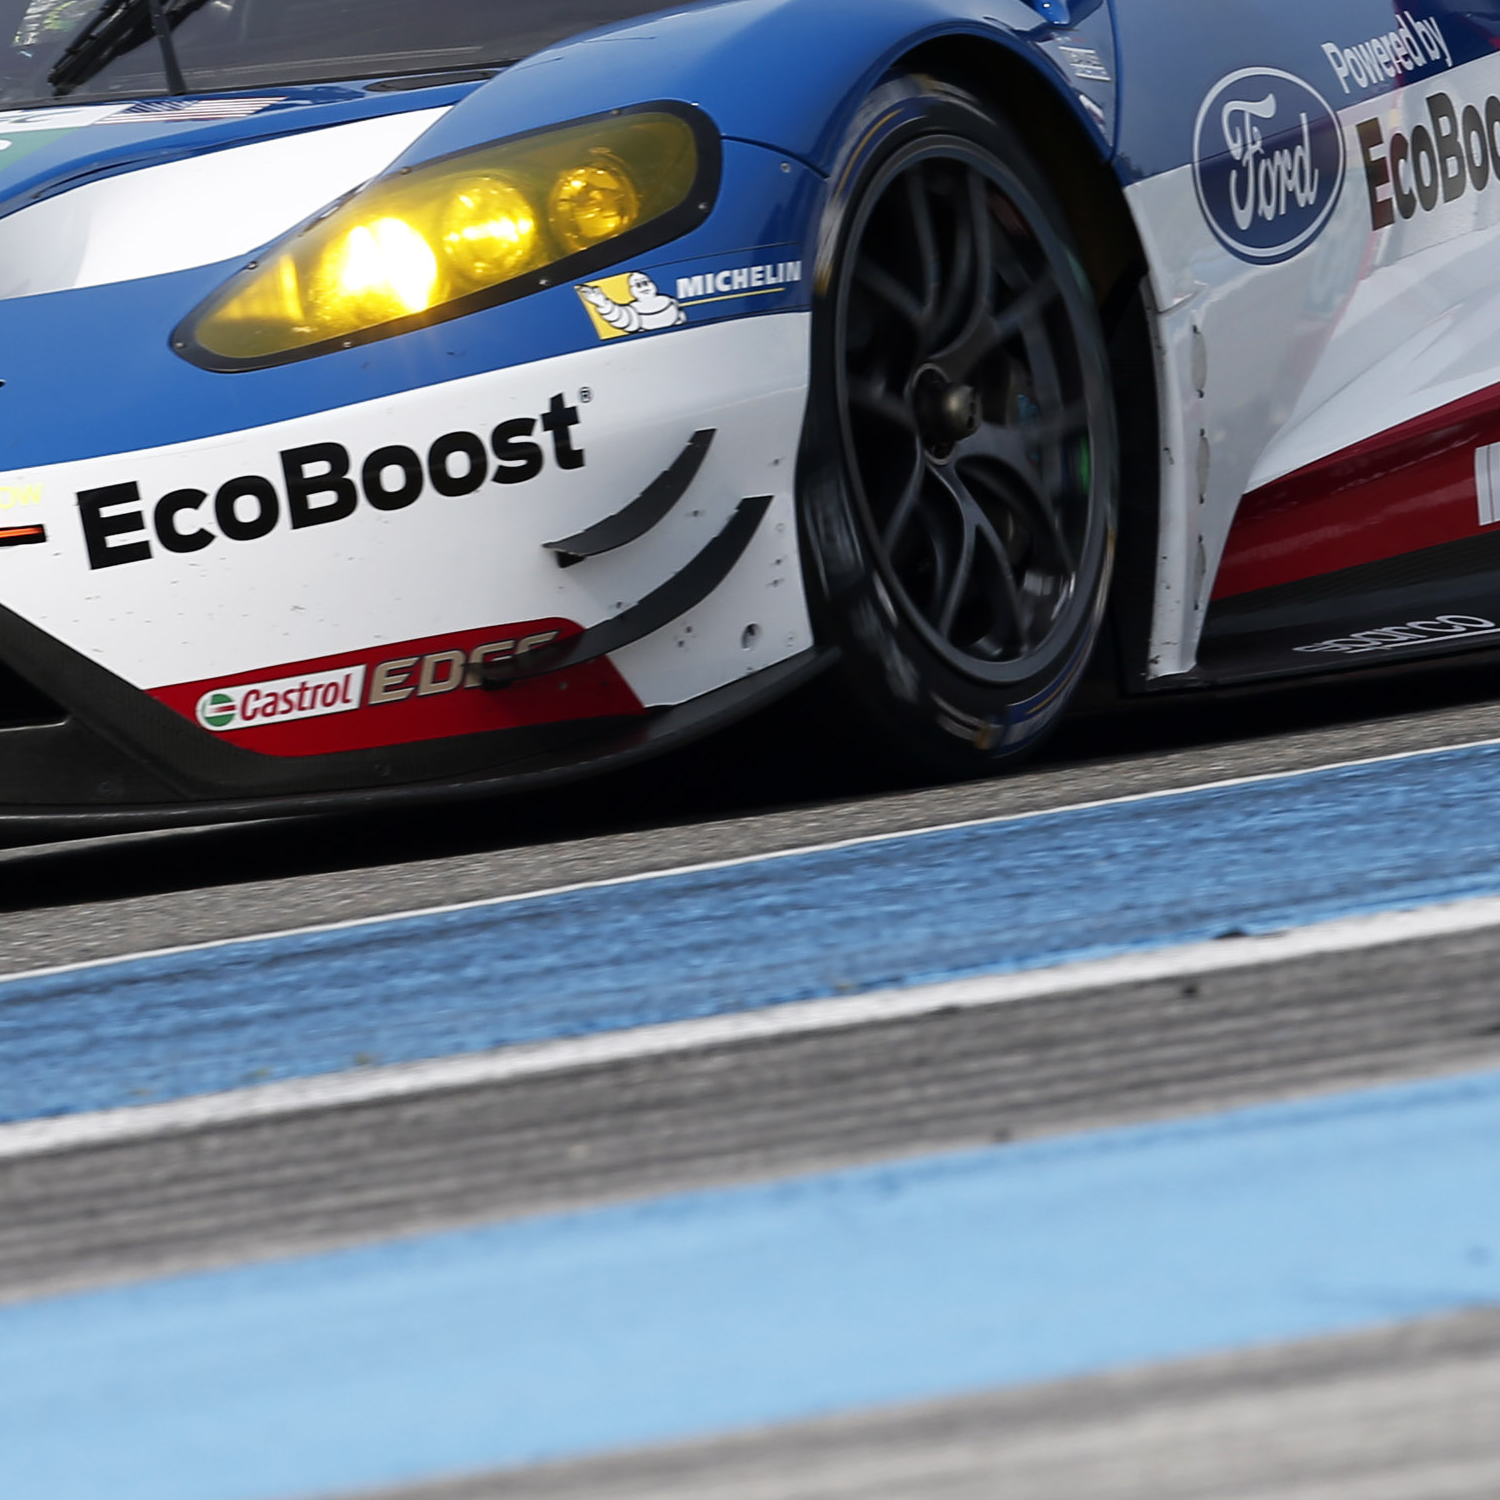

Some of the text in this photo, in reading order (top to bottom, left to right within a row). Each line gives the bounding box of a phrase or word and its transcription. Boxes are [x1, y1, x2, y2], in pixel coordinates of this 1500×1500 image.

[1321, 11, 1453, 94] Powered by
[1222, 92, 1320, 230] Ford
[676, 260, 801, 294] MICHELIN
[76, 391, 586, 570] EcoBoost
[238, 672, 355, 722] Castrol
